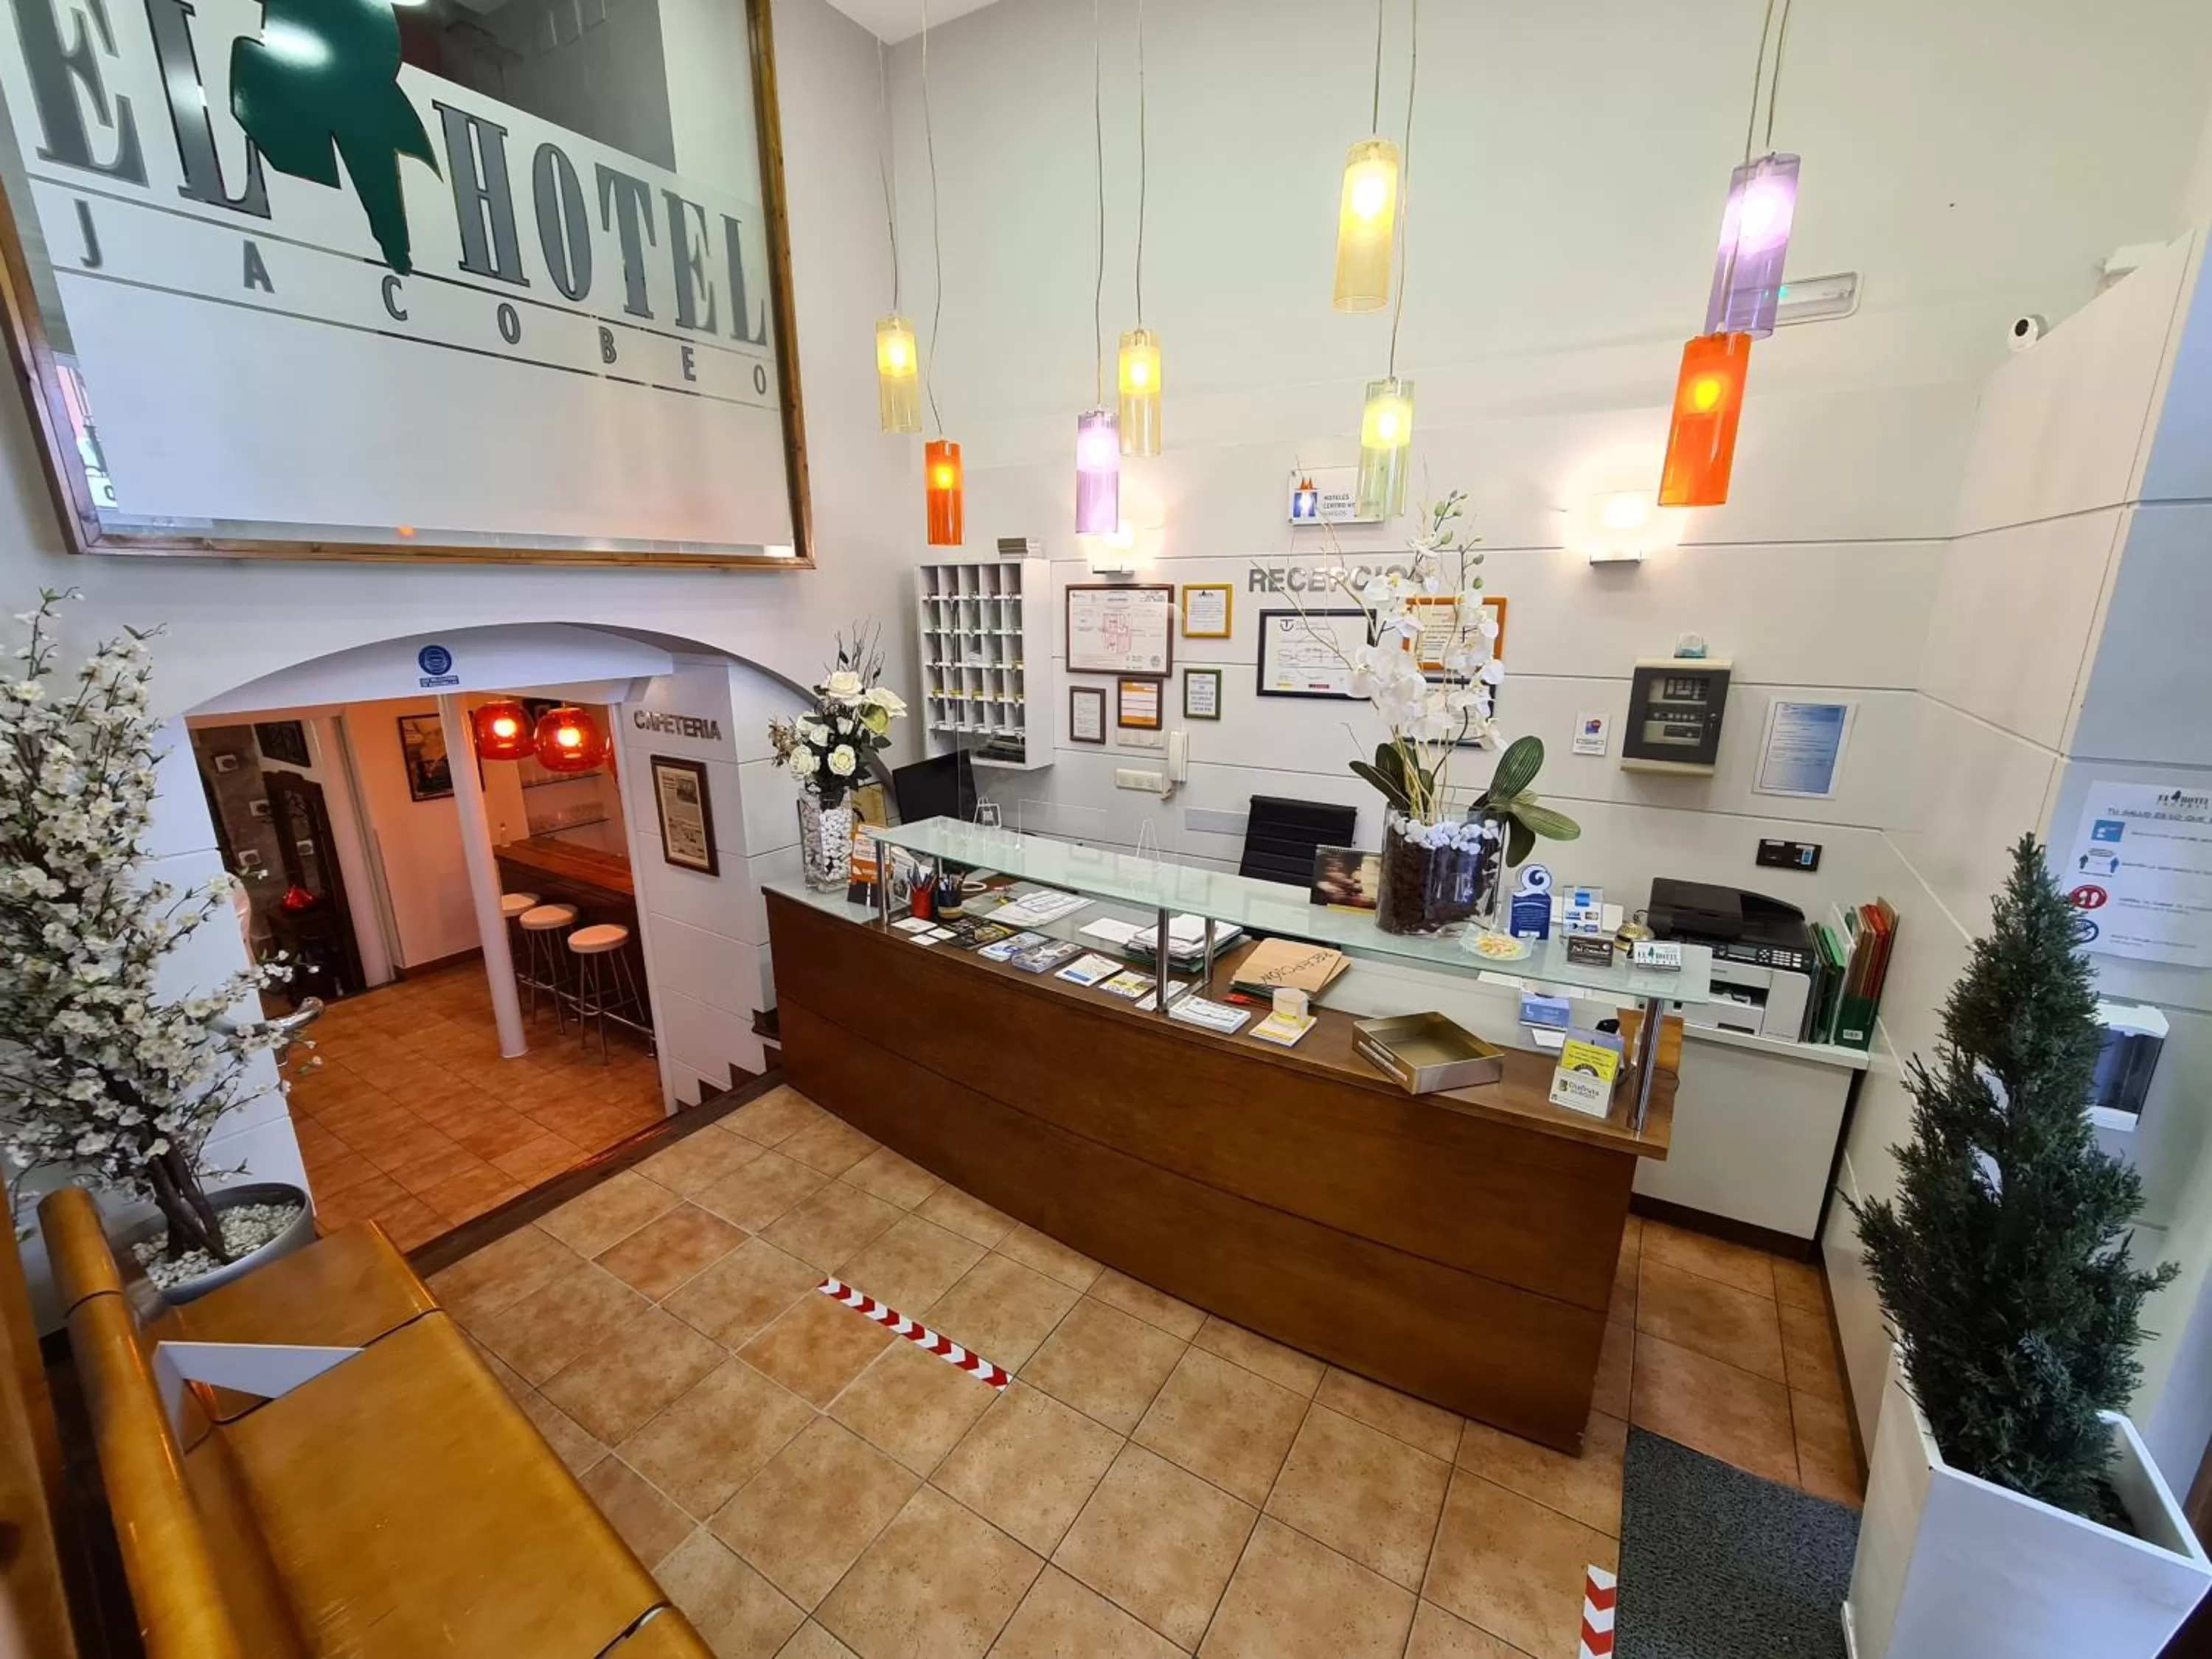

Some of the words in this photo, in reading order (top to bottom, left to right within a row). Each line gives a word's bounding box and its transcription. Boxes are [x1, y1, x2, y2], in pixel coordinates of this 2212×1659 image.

[8, 0, 272, 220] EL
[432, 100, 768, 348] HOTEL
[76, 199, 768, 397] JACOBEO
[1248, 566, 1425, 593] RECEPCIO
[633, 709, 722, 741] CAFETERIA
